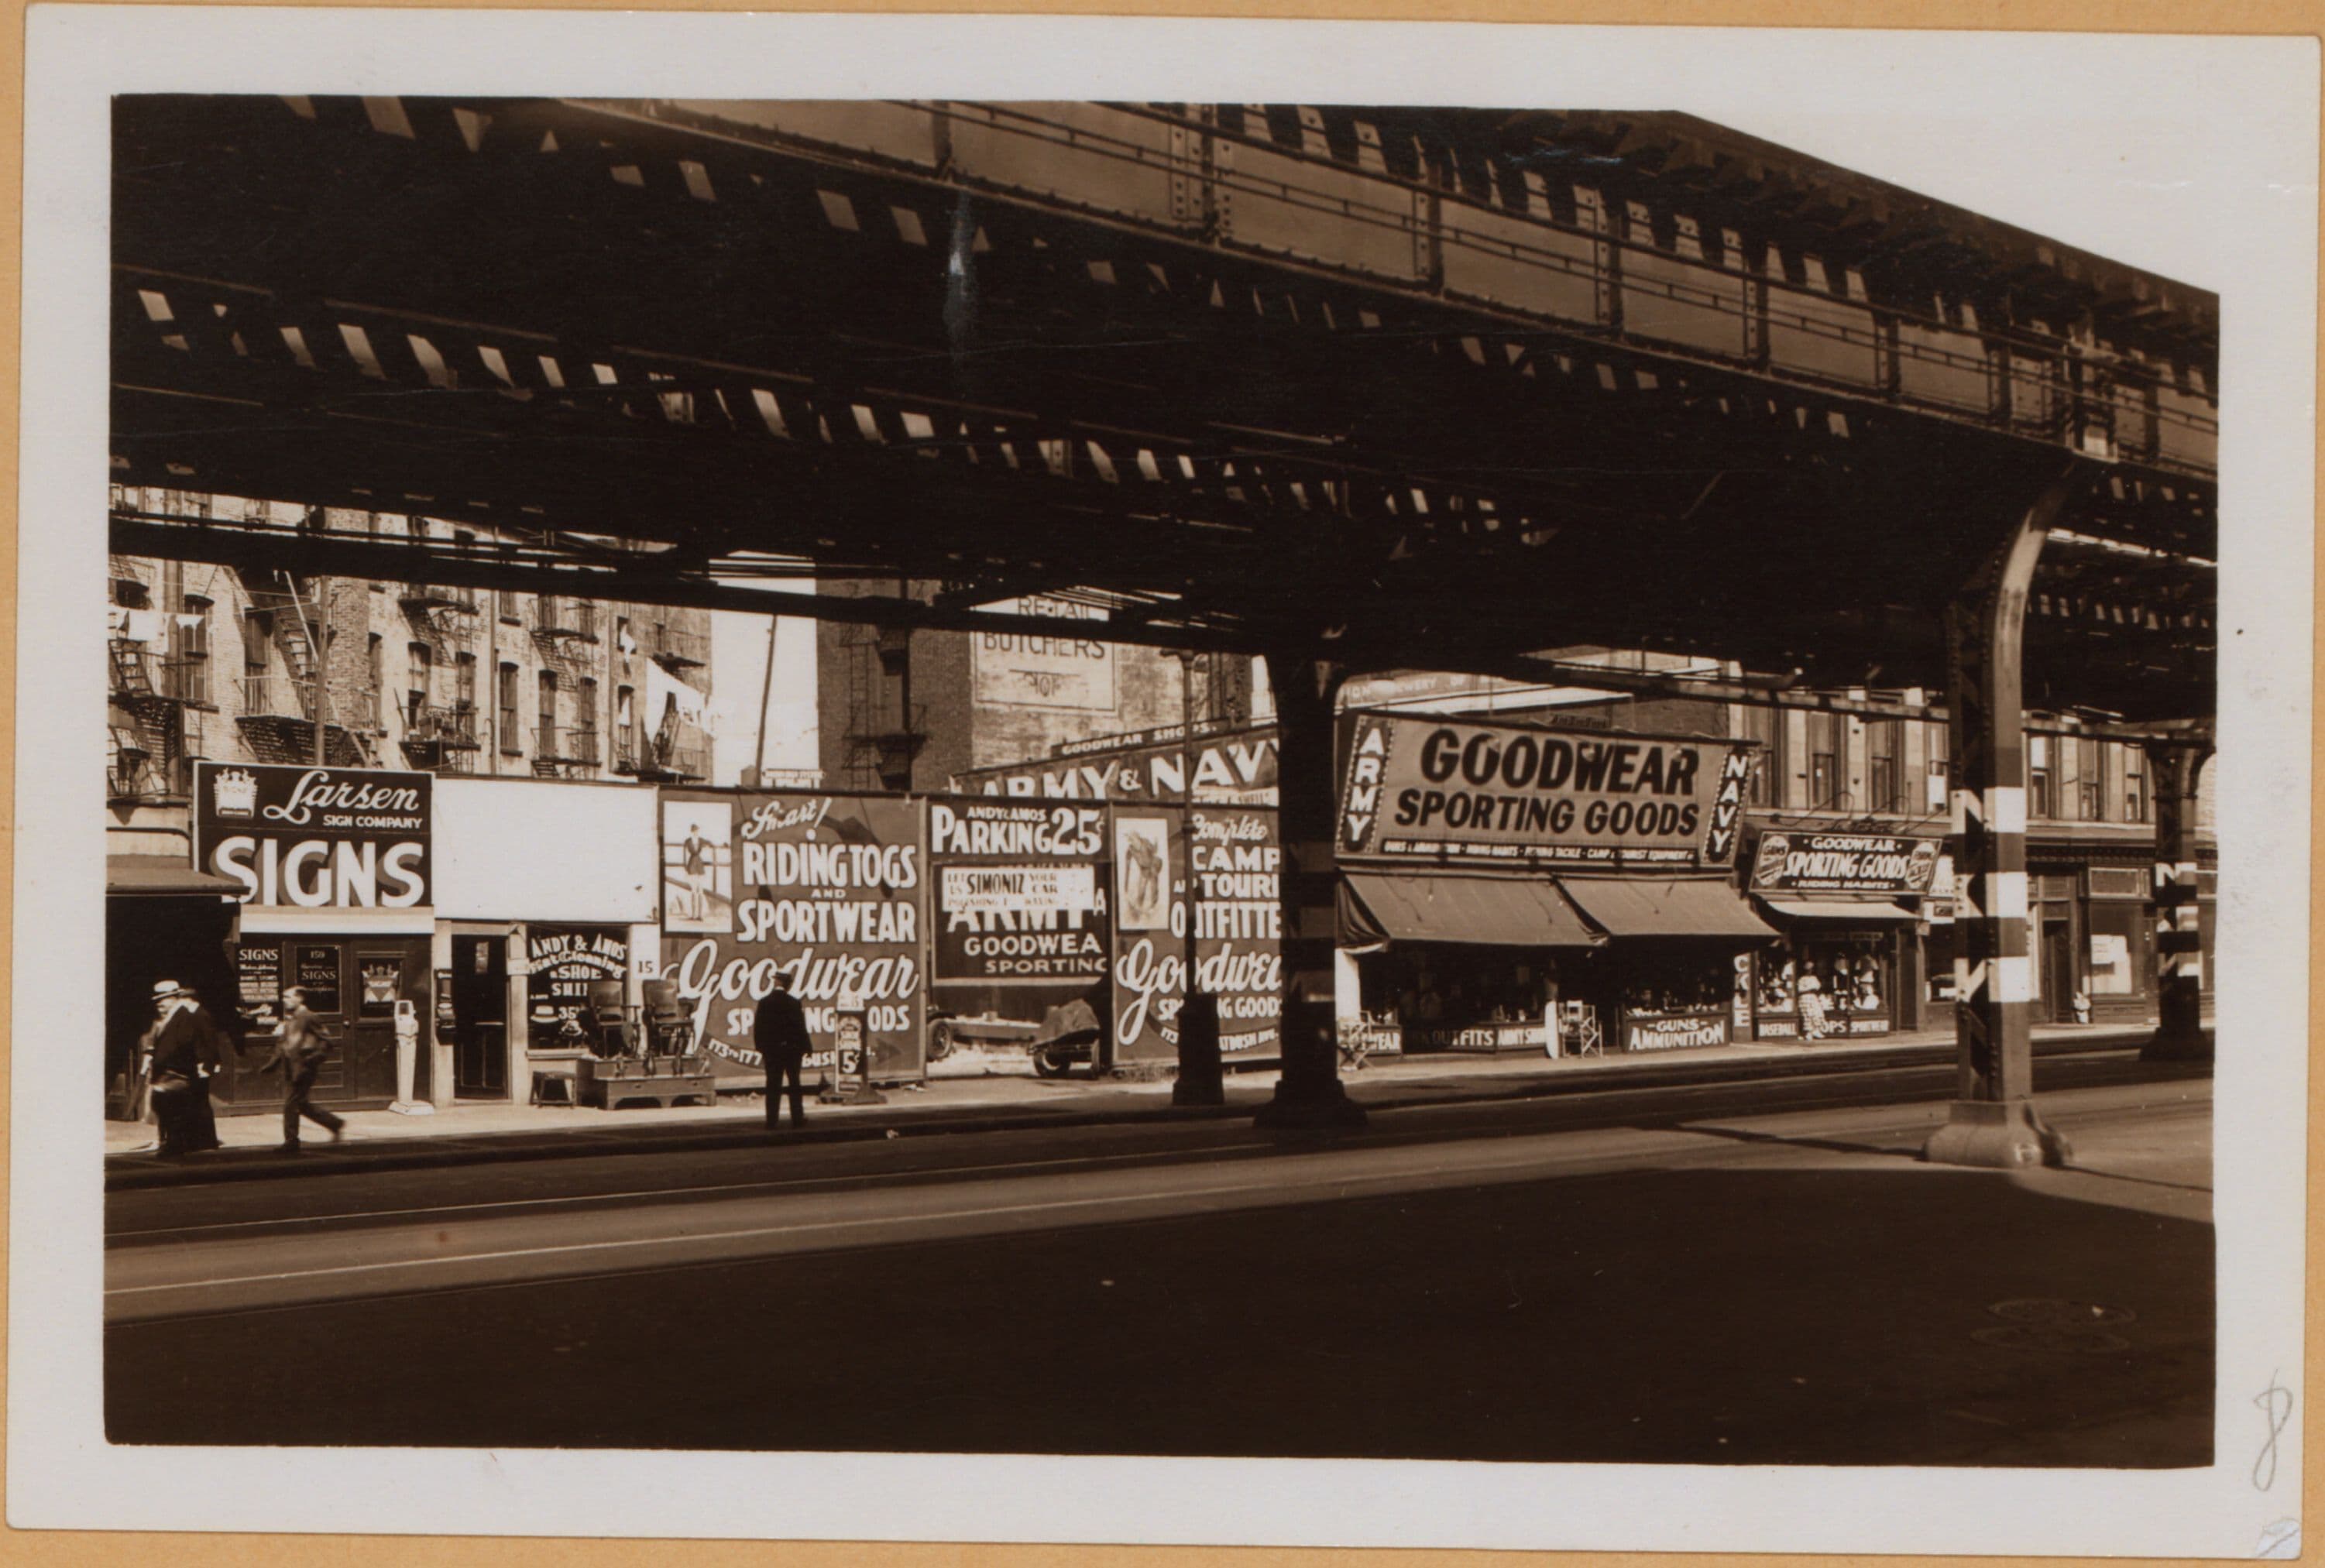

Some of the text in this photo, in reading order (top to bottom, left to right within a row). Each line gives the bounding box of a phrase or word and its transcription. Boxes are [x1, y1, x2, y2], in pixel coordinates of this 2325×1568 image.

[984, 632, 1105, 659] BUTCHERS
[1062, 733, 1142, 756] GOODWEAR
[982, 738, 1279, 800] ARMY & NAV
[1420, 728, 1700, 796] GOODWEAR
[263, 770, 420, 825] Larsen
[1347, 727, 1383, 843] ARMY
[967, 807, 1001, 820] ANDY
[1394, 788, 1701, 837] SPORTING GOODS
[1710, 754, 1749, 853] NAVY
[323, 815, 423, 830] SIGN COMPANY
[740, 797, 833, 841] Smart!
[931, 805, 1053, 855] PARKING
[1192, 845, 1281, 872] CAMP
[1811, 837, 1896, 852] GOODWEAR
[215, 836, 425, 908] SIGNS
[743, 842, 917, 889] RIDING TOGS
[1783, 851, 1860, 878] SPORTING
[1859, 853, 1911, 880] GOODS
[811, 888, 847, 899] AND
[967, 873, 1025, 895] SIMONIZ
[1200, 873, 1279, 898] TOURI
[737, 899, 916, 943] SPORTWEAR
[1170, 901, 1282, 940] OTFITTE
[239, 949, 279, 961] SIGNS
[531, 934, 571, 959] ANDY
[574, 934, 588, 952] &
[964, 932, 1103, 956] GOODWEA
[300, 970, 337, 981] SIGNS
[558, 965, 603, 980] SHOE
[637, 960, 654, 974] 15
[551, 982, 588, 997] SHI
[661, 938, 919, 1056] Goodwear
[1116, 938, 1283, 1045] Goodwea
[1733, 954, 1750, 1028] CKLE
[726, 1006, 836, 1037] SPNG
[867, 1004, 910, 1031] ODS
[1656, 1017, 1701, 1032] GUNS
[1629, 1019, 1726, 1052] AMMUNITION
